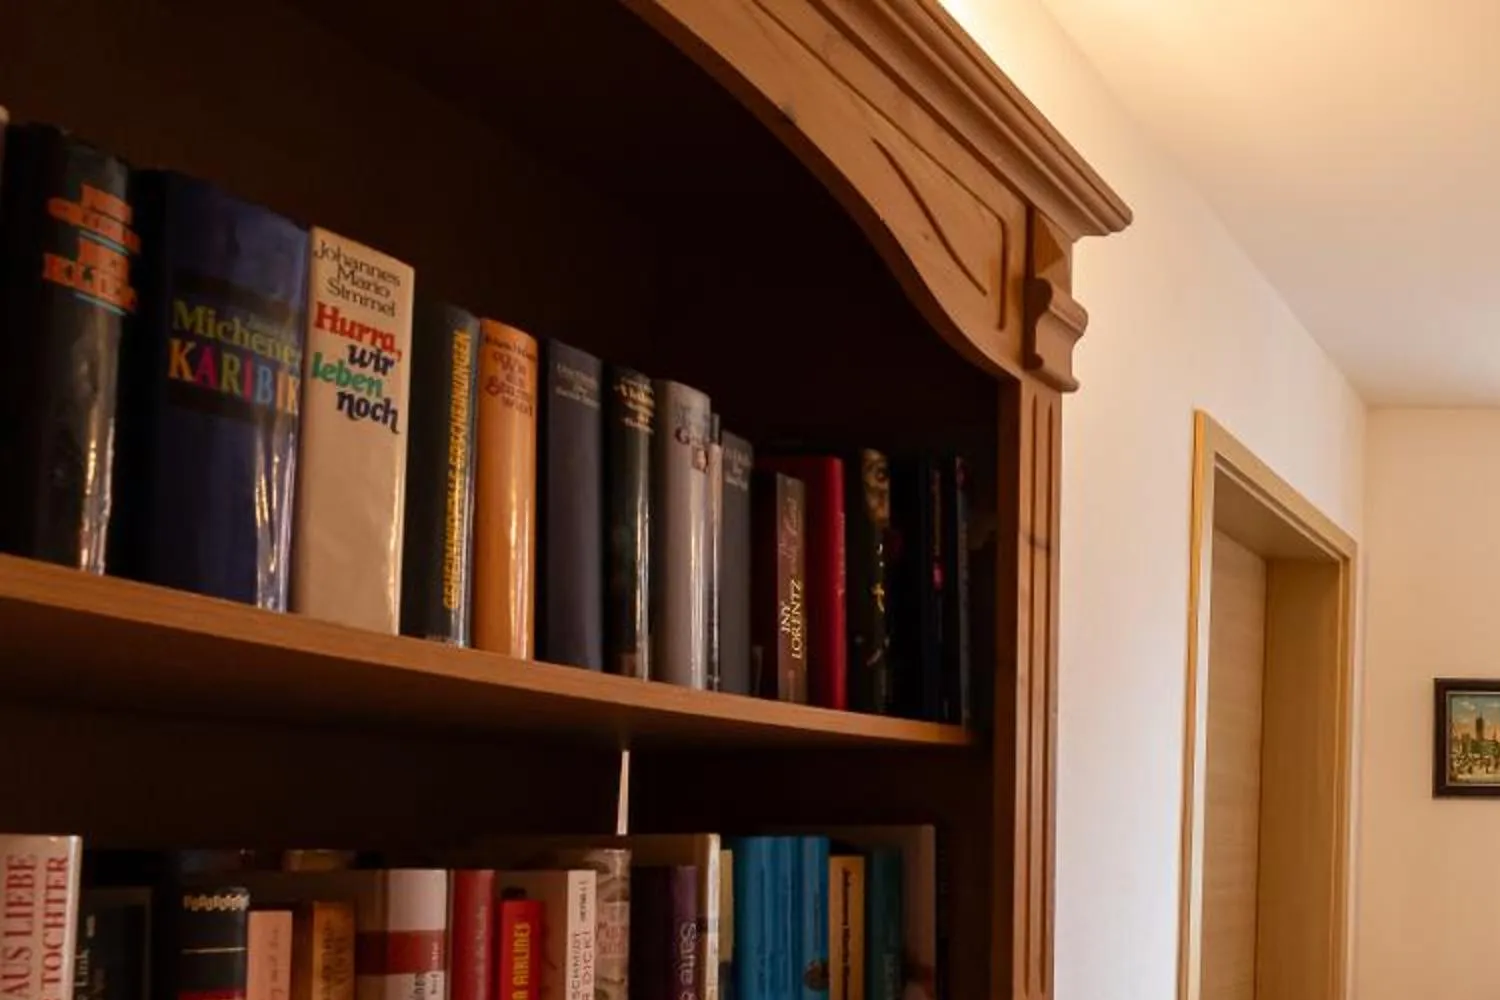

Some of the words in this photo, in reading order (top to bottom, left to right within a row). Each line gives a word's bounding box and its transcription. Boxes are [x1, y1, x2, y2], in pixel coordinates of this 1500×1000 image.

[312, 239, 402, 288] Johannes
[336, 262, 392, 299] Mario
[326, 279, 397, 318] Simmel
[314, 302, 403, 363] Hurra,
[312, 351, 383, 397] leben
[347, 344, 395, 377] wir
[336, 388, 401, 435] noch
[780, 601, 791, 634] INY
[791, 579, 802, 660] LORENTZ
[4, 854, 36, 938] LIEBE
[41, 857, 68, 991] TOCHTER
[1, 945, 33, 999] AUS
[73, 947, 90, 988] Link
